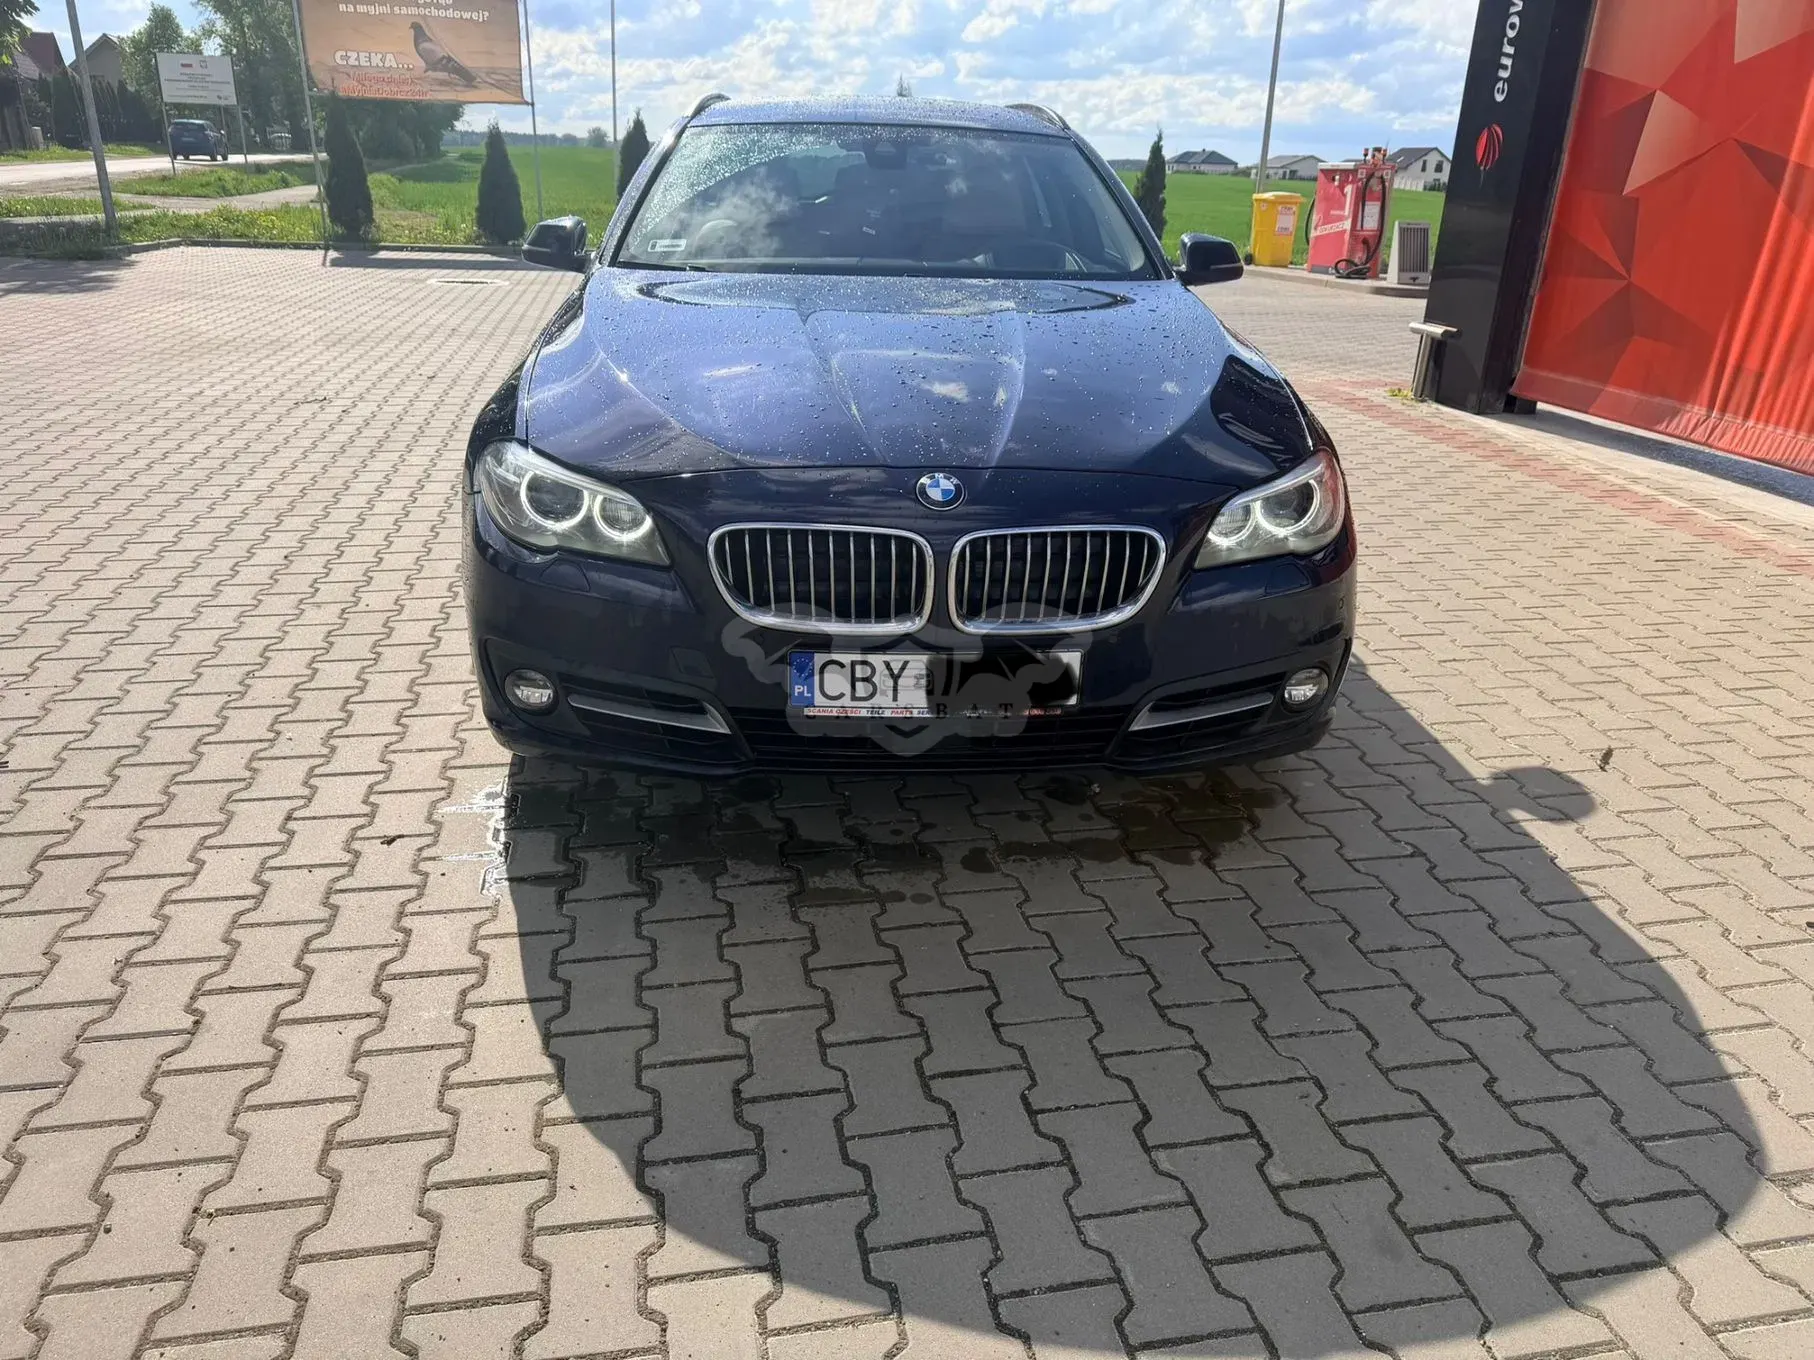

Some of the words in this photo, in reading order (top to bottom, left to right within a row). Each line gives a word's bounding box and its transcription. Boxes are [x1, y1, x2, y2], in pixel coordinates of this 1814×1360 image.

[339, 4, 354, 12] na
[356, 3, 391, 15] myjni
[393, 6, 490, 21] samochodowej?
[334, 50, 414, 70] CZEKA...
[818, 658, 910, 702] CBY
[794, 685, 812, 697] PL
